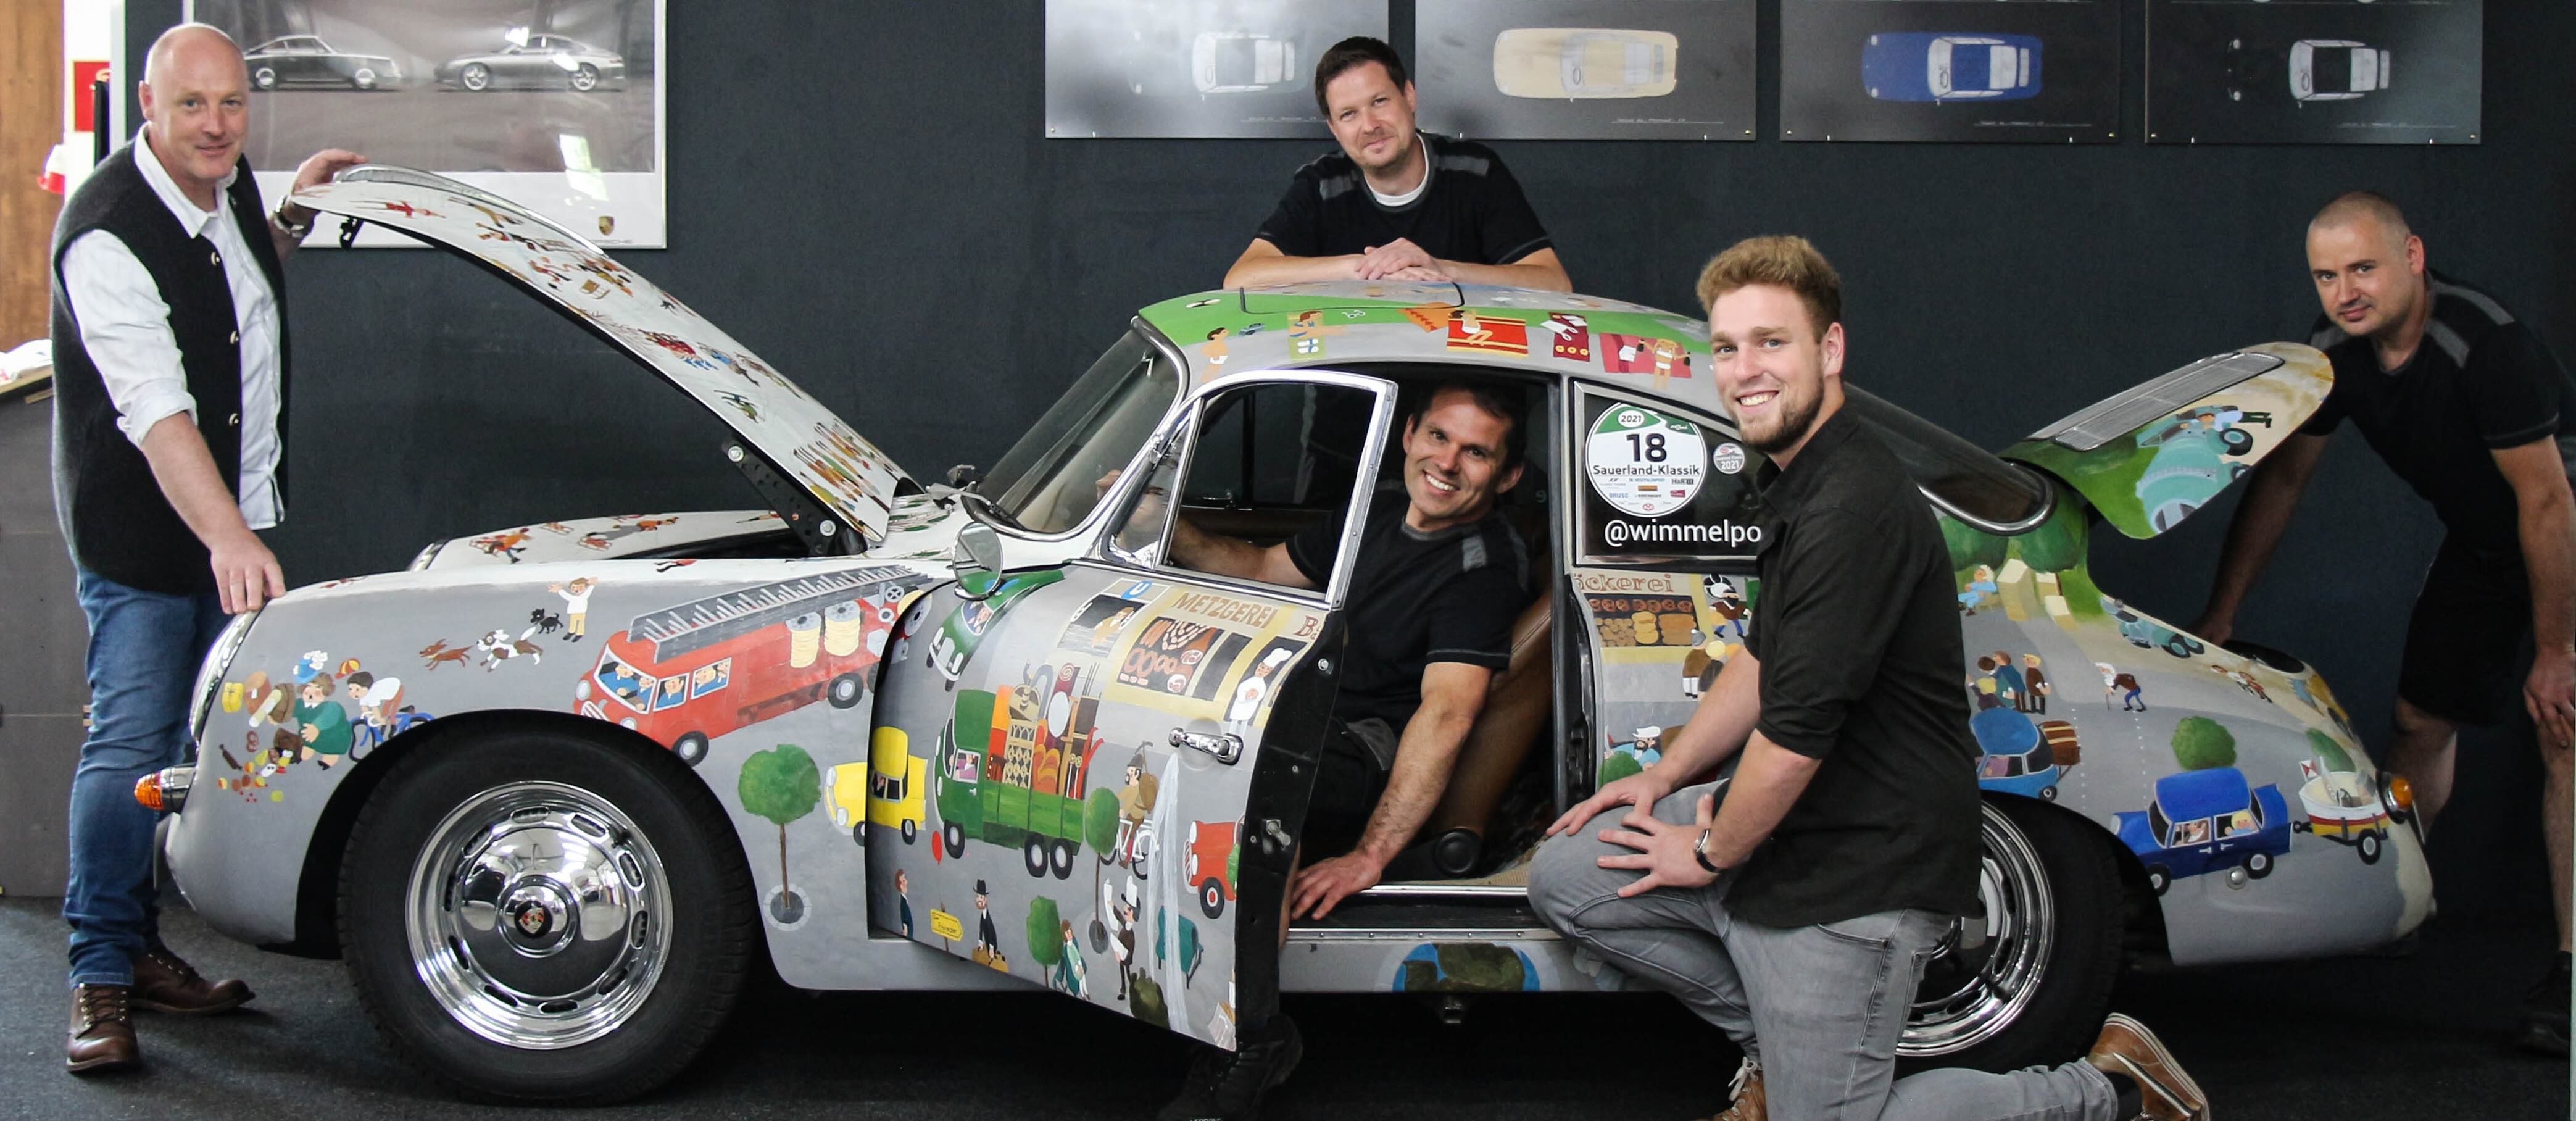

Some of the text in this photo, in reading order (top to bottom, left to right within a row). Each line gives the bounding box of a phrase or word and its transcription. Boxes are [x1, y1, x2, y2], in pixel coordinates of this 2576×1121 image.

[1621, 415, 1642, 423] 2021
[1626, 433, 1667, 462] 18
[1593, 464, 1700, 476] Sauerland-Klassik
[1721, 460, 1739, 470] 2021
[1605, 519, 1761, 548] @wimmelpo
[1171, 592, 1279, 629] METZGEREI
